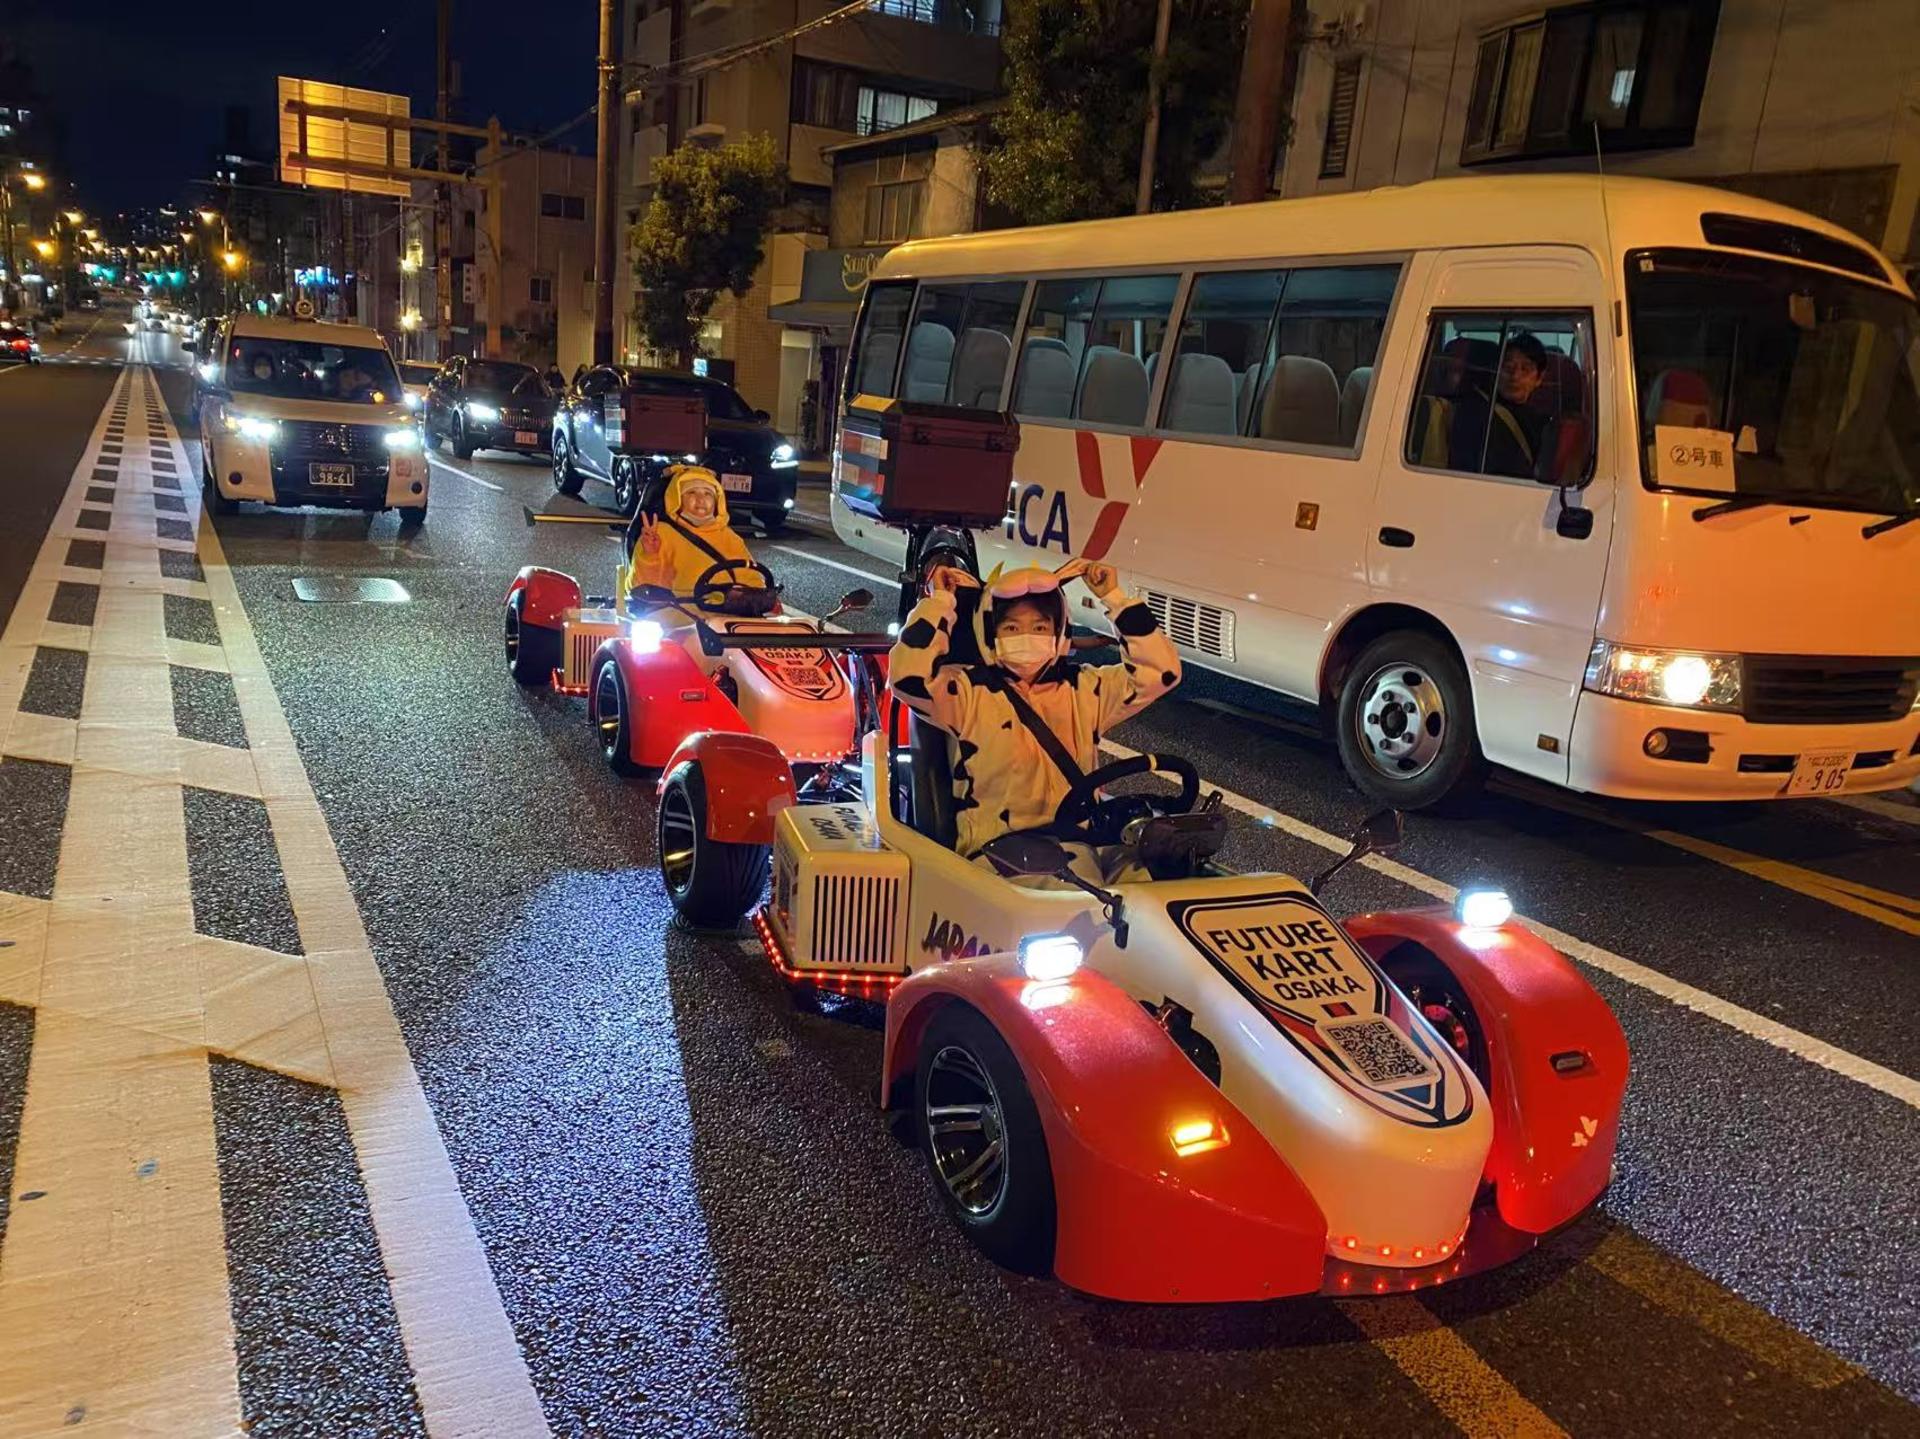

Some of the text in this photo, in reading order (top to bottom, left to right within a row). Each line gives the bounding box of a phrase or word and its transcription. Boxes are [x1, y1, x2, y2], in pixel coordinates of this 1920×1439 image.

[764, 651, 815, 659] OSAKA
[1206, 920, 1338, 953] FUTURE
[1245, 947, 1344, 981] KART
[1273, 975, 1367, 1001] OSAKA
